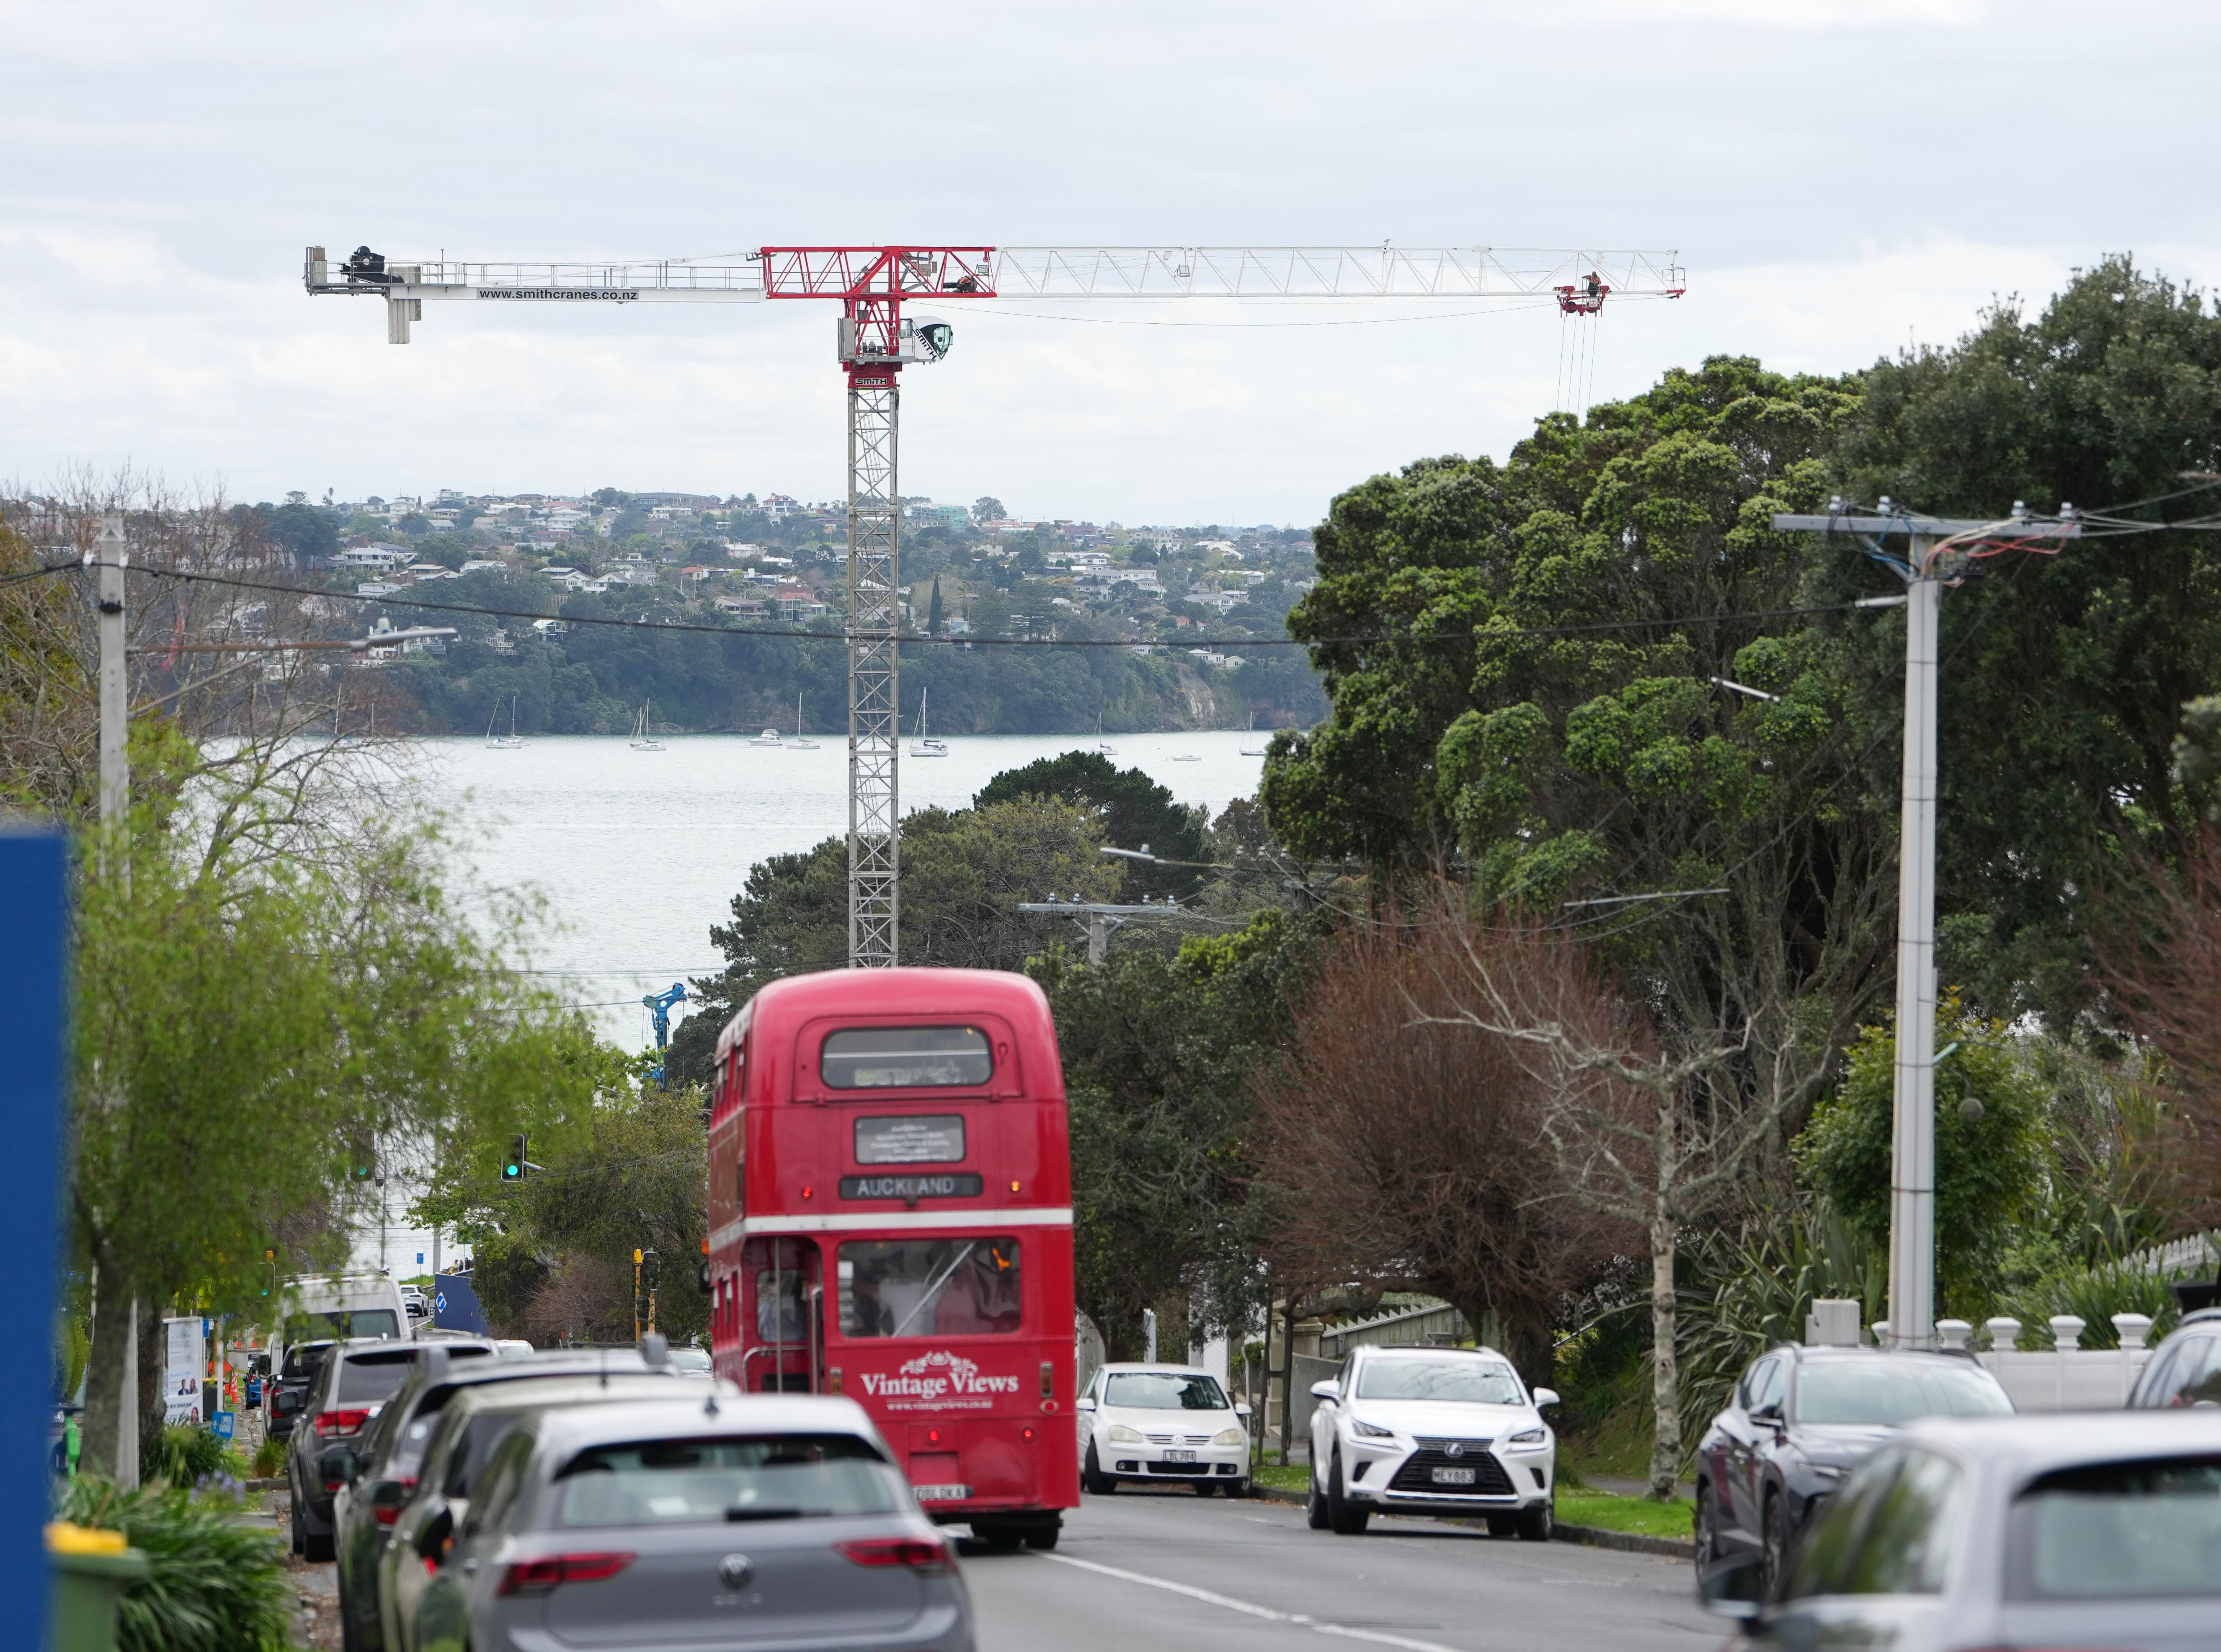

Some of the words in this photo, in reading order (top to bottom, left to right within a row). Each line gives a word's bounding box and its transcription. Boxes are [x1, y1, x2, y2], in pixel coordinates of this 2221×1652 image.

[479, 289, 637, 300] www.smithcranes.co.nz
[858, 1177, 954, 1196] AUCKLAND
[860, 1373, 947, 1399] Vintage
[949, 1371, 1019, 1393] Views
